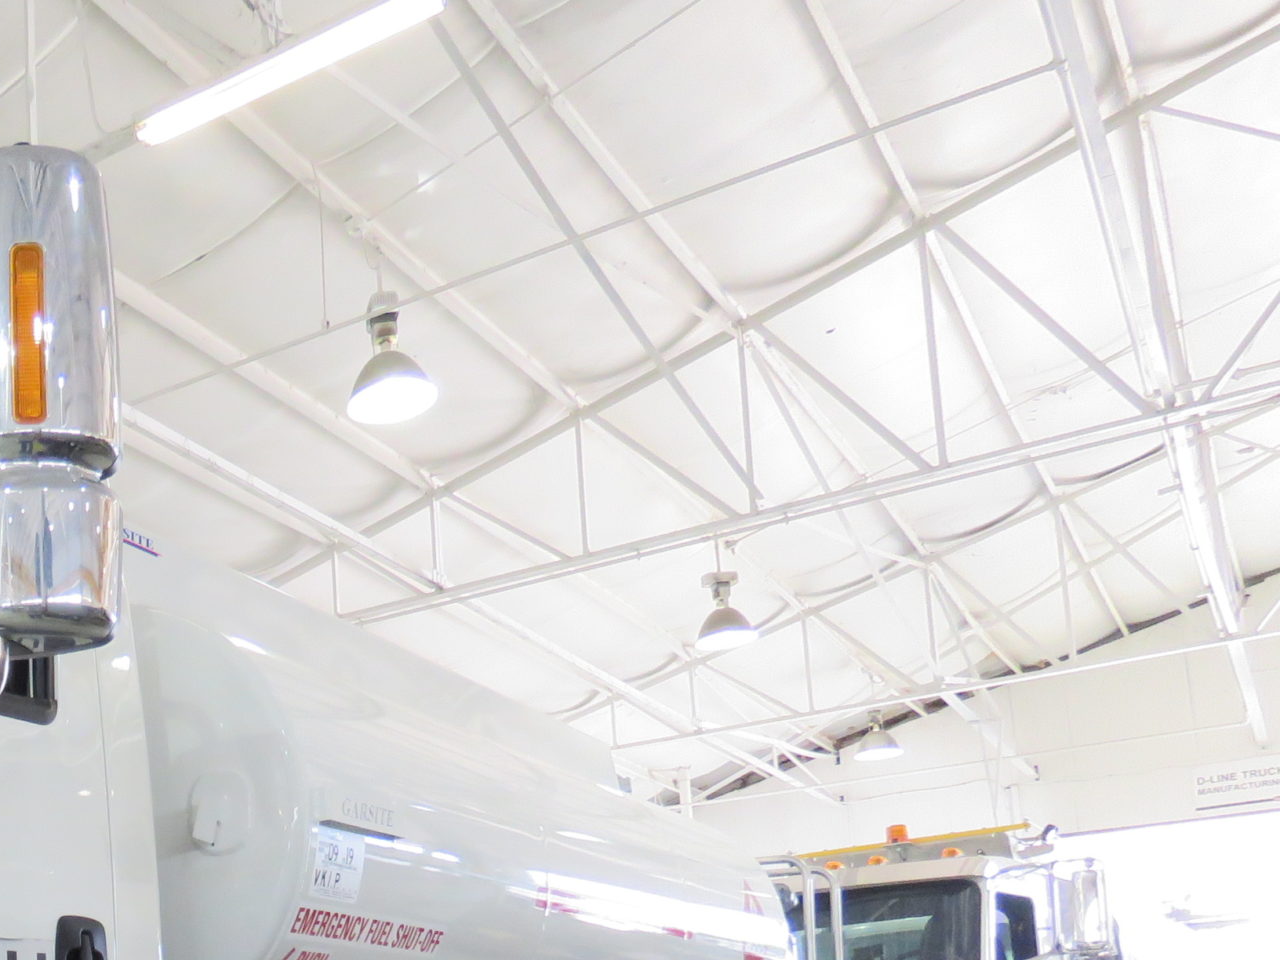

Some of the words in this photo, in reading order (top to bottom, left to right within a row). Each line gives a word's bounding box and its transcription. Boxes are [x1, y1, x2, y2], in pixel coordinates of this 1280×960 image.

[1196, 772, 1237, 786] D-LINE
[341, 798, 395, 828] GARSITE
[290, 907, 369, 942] EMERGENCY
[364, 919, 394, 947] FUEL
[391, 923, 444, 953] SHUT-OFF
